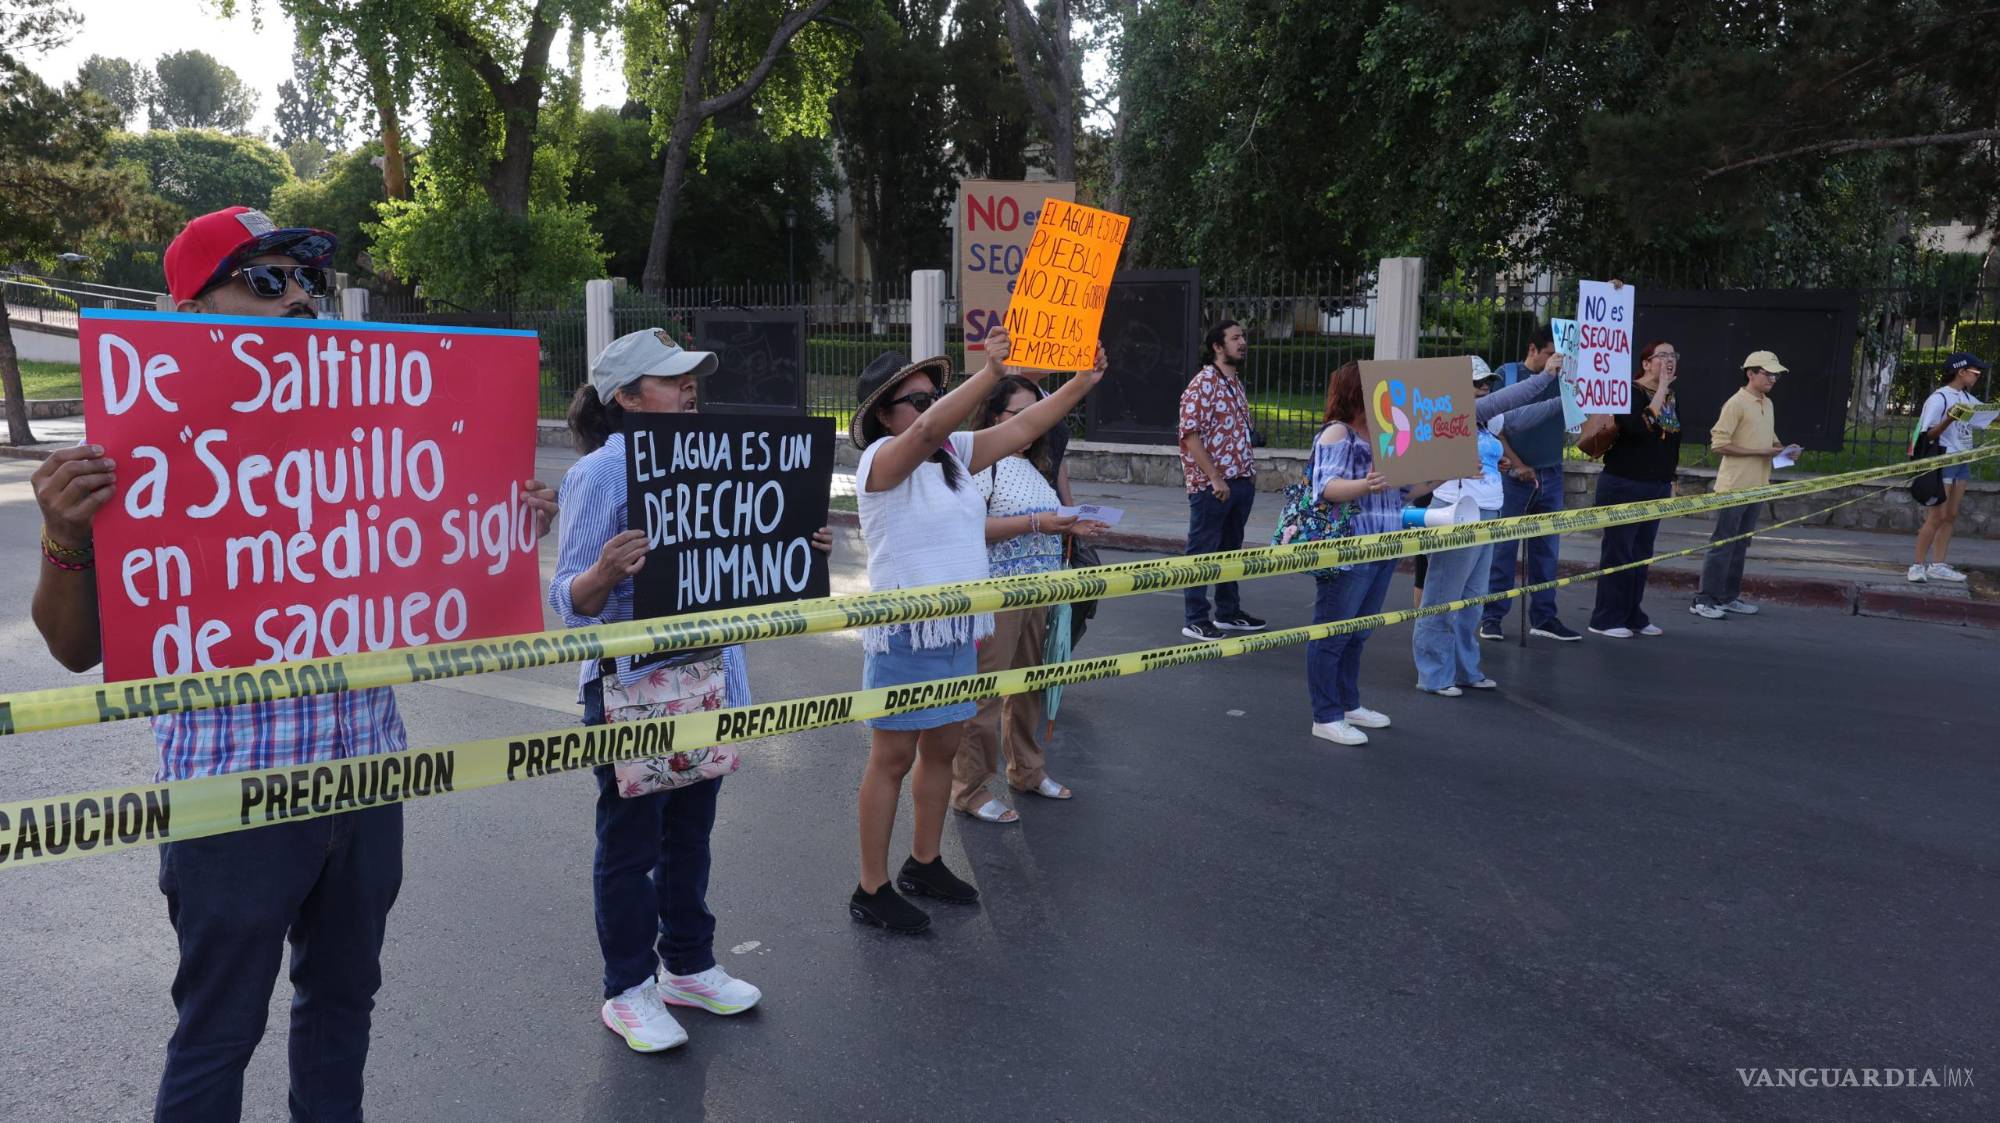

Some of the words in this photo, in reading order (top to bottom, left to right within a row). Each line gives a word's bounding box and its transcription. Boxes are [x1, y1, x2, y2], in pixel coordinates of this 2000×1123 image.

[967, 193, 1019, 232] NO
[1042, 202, 1058, 226] EL
[1060, 206, 1094, 238] AGUA
[1097, 215, 1112, 241] ES
[968, 243, 1028, 275] SEQ
[1026, 229, 1102, 278] PUEBLO
[1017, 269, 1048, 299] NO
[1048, 275, 1078, 307] DEL
[1009, 307, 1029, 335] NI
[1033, 311, 1057, 339] DE
[1062, 315, 1083, 343] LAS
[1585, 296, 1606, 322] NO
[1611, 305, 1624, 322] es
[1010, 337, 1091, 367] EMPRESAS
[1580, 324, 1630, 354] SEQUIA
[98, 333, 180, 416] De
[1594, 352, 1611, 374] es
[1413, 388, 1453, 420] Aguas
[1576, 377, 1628, 408] SAQUEO
[1414, 420, 1432, 442] de
[633, 430, 667, 483] EL
[671, 431, 733, 474] AGUA
[741, 431, 771, 472] ES
[780, 433, 813, 472] UN
[125, 446, 169, 520] a
[644, 479, 785, 551] DERECHO
[121, 545, 192, 607] en
[226, 505, 421, 591] medio
[442, 480, 536, 576] siglo
[677, 536, 812, 611] HUMANO
[152, 605, 232, 677] de
[254, 587, 468, 666] saqueo
[507, 721, 675, 782] PRECAUCION
[241, 751, 454, 825] PRECAUCION
